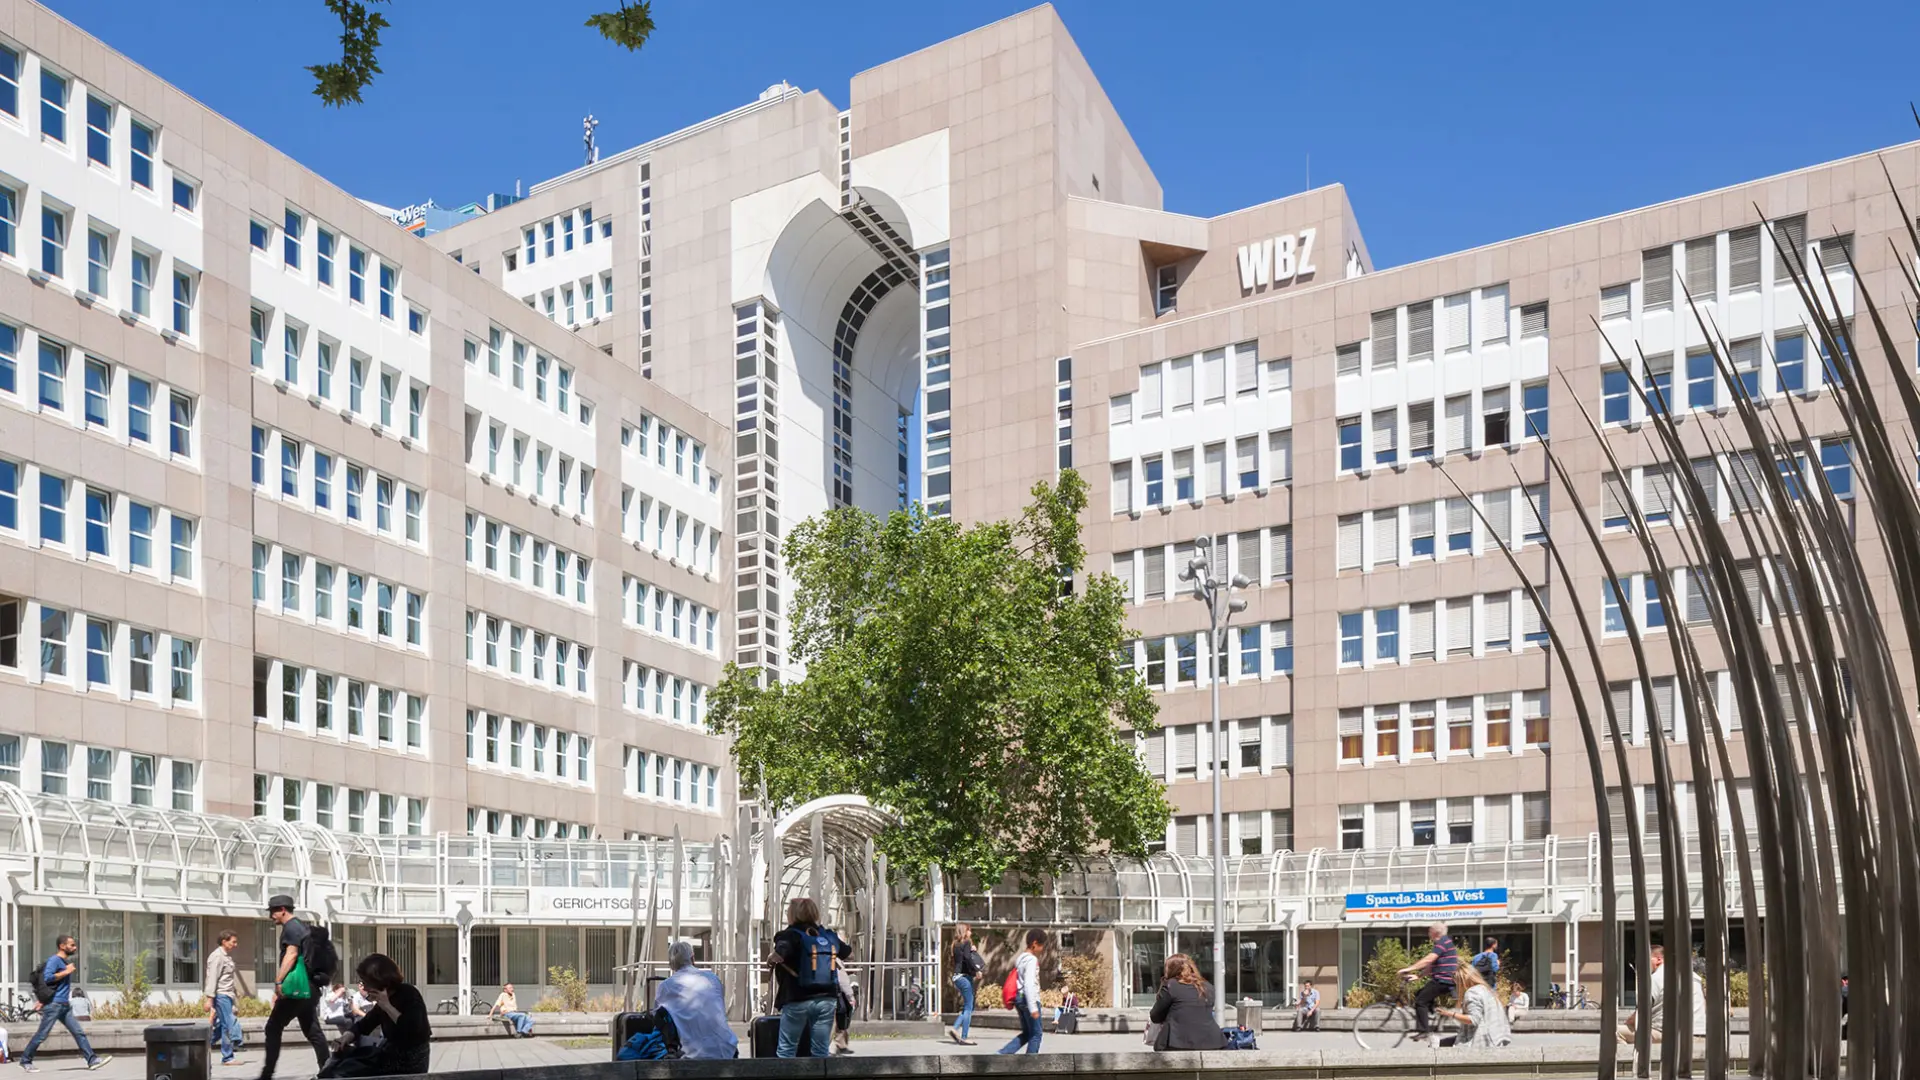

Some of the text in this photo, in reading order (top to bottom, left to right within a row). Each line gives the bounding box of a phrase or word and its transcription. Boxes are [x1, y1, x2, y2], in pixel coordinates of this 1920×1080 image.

[1238, 228, 1316, 290] WBZ
[553, 898, 673, 910] GERICHTSGBUD
[1366, 889, 1485, 908] Sparda-Bank West
